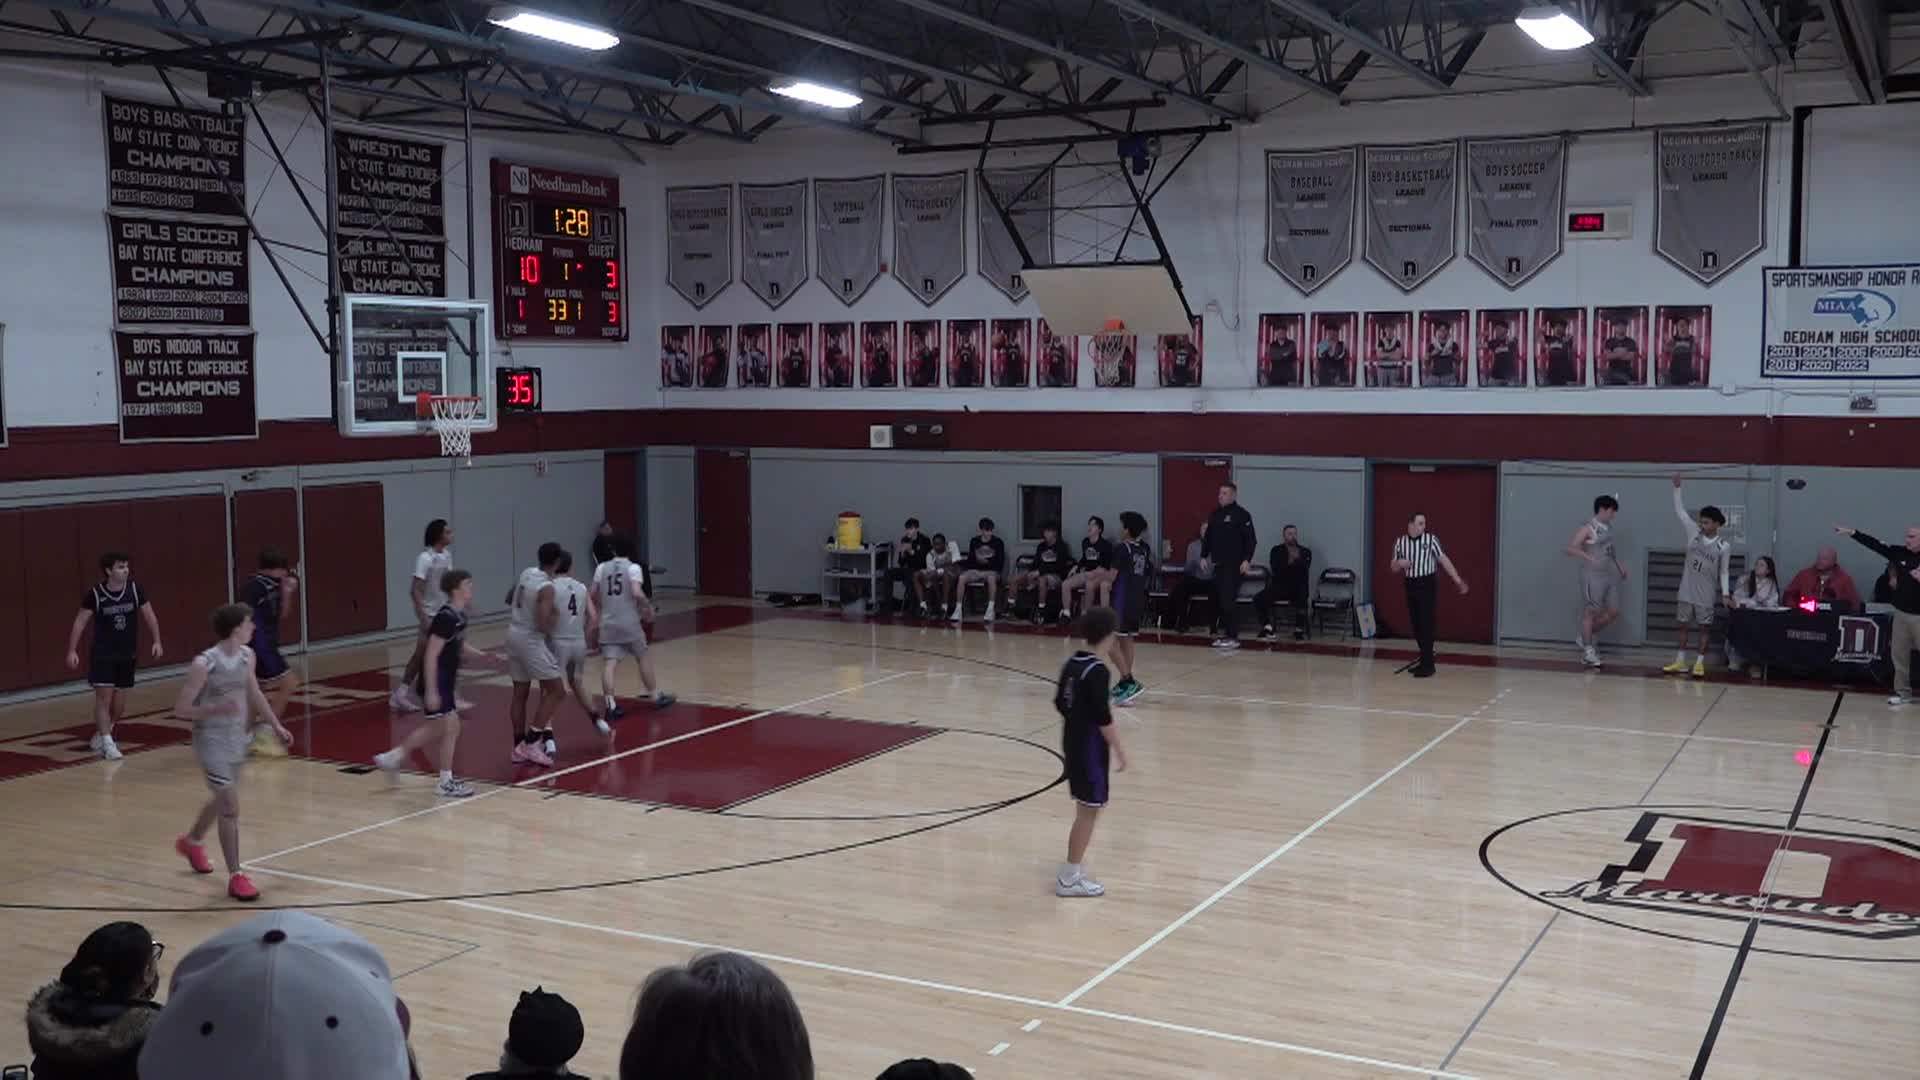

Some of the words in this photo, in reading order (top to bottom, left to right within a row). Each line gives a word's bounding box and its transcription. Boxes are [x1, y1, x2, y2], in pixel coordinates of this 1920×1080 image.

[111, 104, 150, 124] BOYS
[113, 126, 133, 143] BAY
[138, 130, 173, 148] STATE
[348, 138, 431, 162] WRESTLING
[127, 150, 231, 175] CHAMPIONS
[359, 159, 385, 176] STATE
[1485, 164, 1508, 176] BOYS
[1511, 162, 1546, 176] SOCCER
[1290, 176, 1333, 188] BASEBALL
[1371, 170, 1392, 182] BOYS
[1394, 168, 1450, 183] BASKETBALL
[555, 208, 589, 236] 1:28
[1489, 218, 1514, 228] FINAL
[1516, 218, 1538, 227] FOUR
[122, 223, 171, 241] GIRLS
[176, 227, 239, 246] SOCCER
[118, 244, 138, 260] BAY
[143, 245, 176, 263] STATE
[181, 249, 243, 266] CONFERENCE
[409, 245, 435, 260] TRACK
[588, 243, 615, 258] GUEST
[361, 260, 388, 275] STATE
[521, 256, 539, 283] 10
[606, 261, 617, 288] 3
[131, 267, 234, 286] CHAMPIONS
[1772, 272, 1863, 288] SPORTSMANSHIP
[1868, 270, 1906, 286] HONOR
[548, 299, 567, 321] 33
[608, 301, 617, 322] 3
[1817, 300, 1857, 311] MIAA
[1784, 331, 1834, 344] DEDHAM
[1840, 330, 1869, 343] HIGH
[1875, 329, 1920, 343] SCHOOL
[133, 339, 161, 354] BOYS
[166, 339, 203, 354] INDOOR
[207, 339, 239, 354] TRACK
[1769, 346, 1798, 358] 2001
[125, 360, 144, 375] BAY
[149, 360, 183, 375] STATE
[187, 360, 248, 375] CONFERENCE
[367, 361, 392, 374] STATE
[1769, 360, 1797, 371] 2018
[1802, 360, 1832, 371] 2020
[1837, 360, 1867, 371] 2022
[137, 381, 240, 397] CHAMPIONS
[607, 573, 623, 596] 15
[567, 593, 577, 616] 4
[1838, 616, 1880, 663] D
